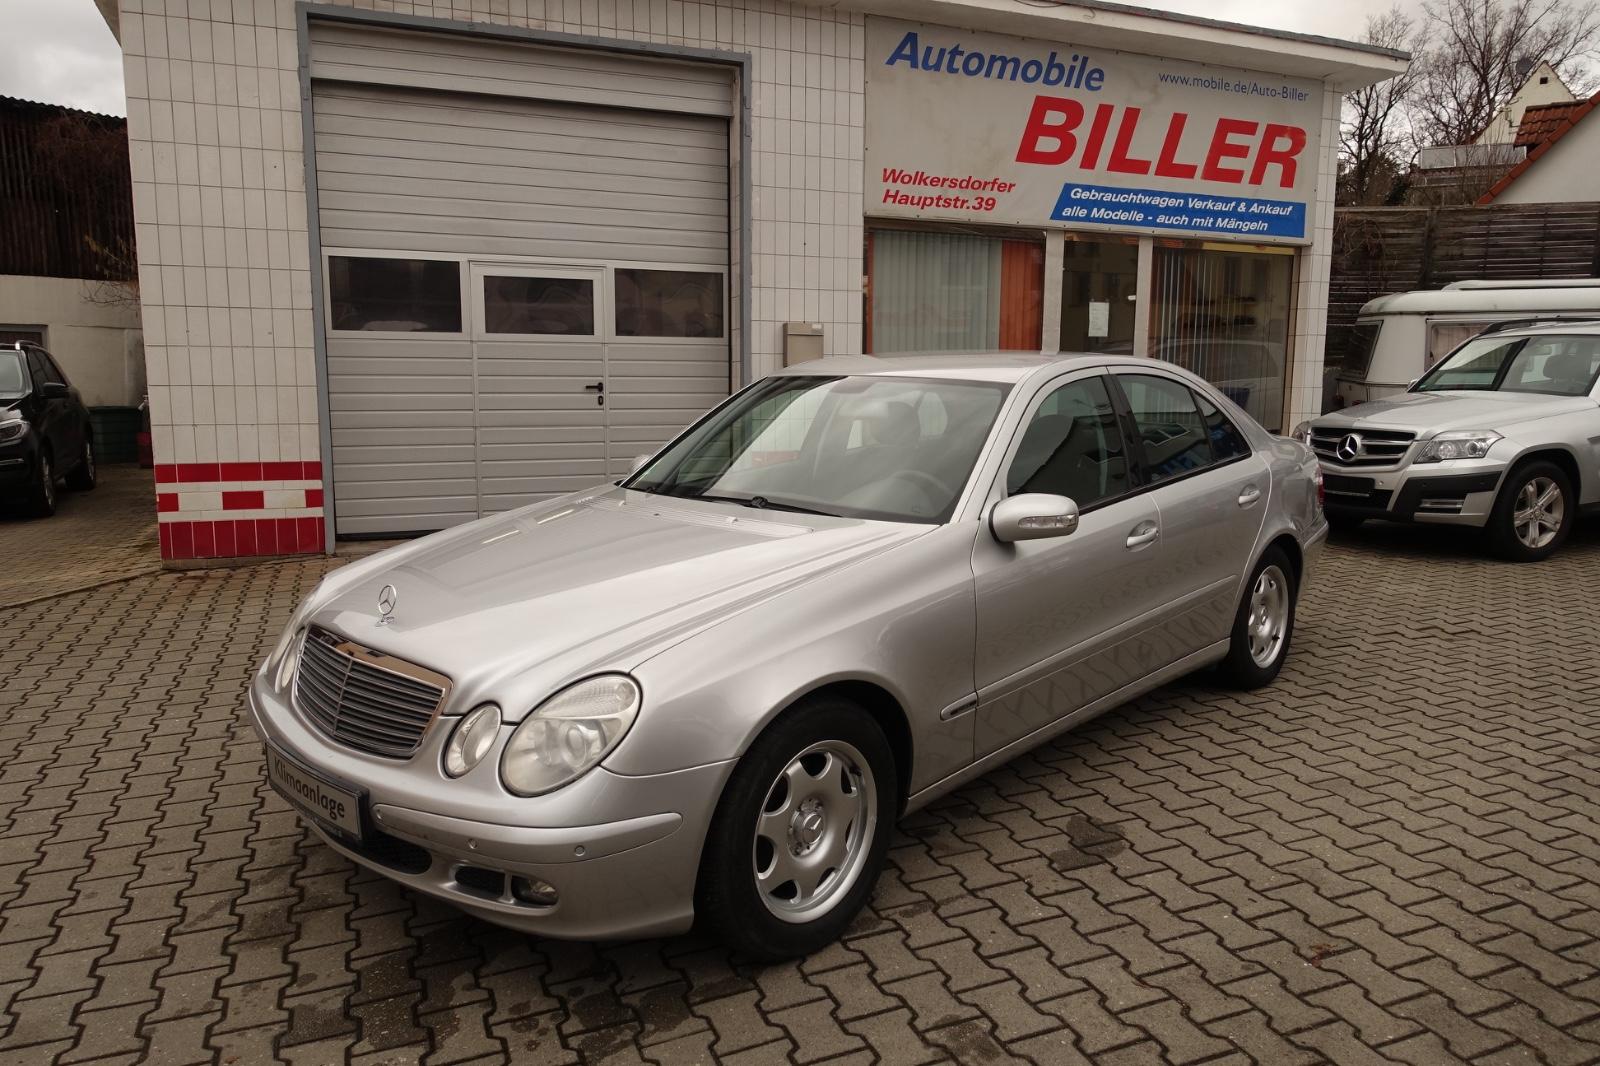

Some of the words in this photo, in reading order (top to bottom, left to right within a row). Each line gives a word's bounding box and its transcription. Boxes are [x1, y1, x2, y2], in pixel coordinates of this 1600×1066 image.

[885, 31, 1104, 92] Automobile
[1158, 72, 1309, 102] www.mobile.de/Auto-Biller
[1015, 95, 1307, 188] BILLER
[882, 168, 1016, 193] Wolkersdorfer
[882, 189, 997, 211] Hauptstr.39
[1070, 188, 1184, 208] Gebrauchtwagen
[1188, 199, 1236, 213] Verkauf
[1237, 204, 1247, 213] &
[1250, 204, 1293, 216] Ankauf
[1062, 206, 1088, 217] alle
[1090, 207, 1144, 222] Modelle
[1156, 213, 1189, 226] auch
[1191, 217, 1214, 228] mit
[1216, 217, 1269, 231] Mängeln
[273, 757, 345, 821] Klimaanlage
